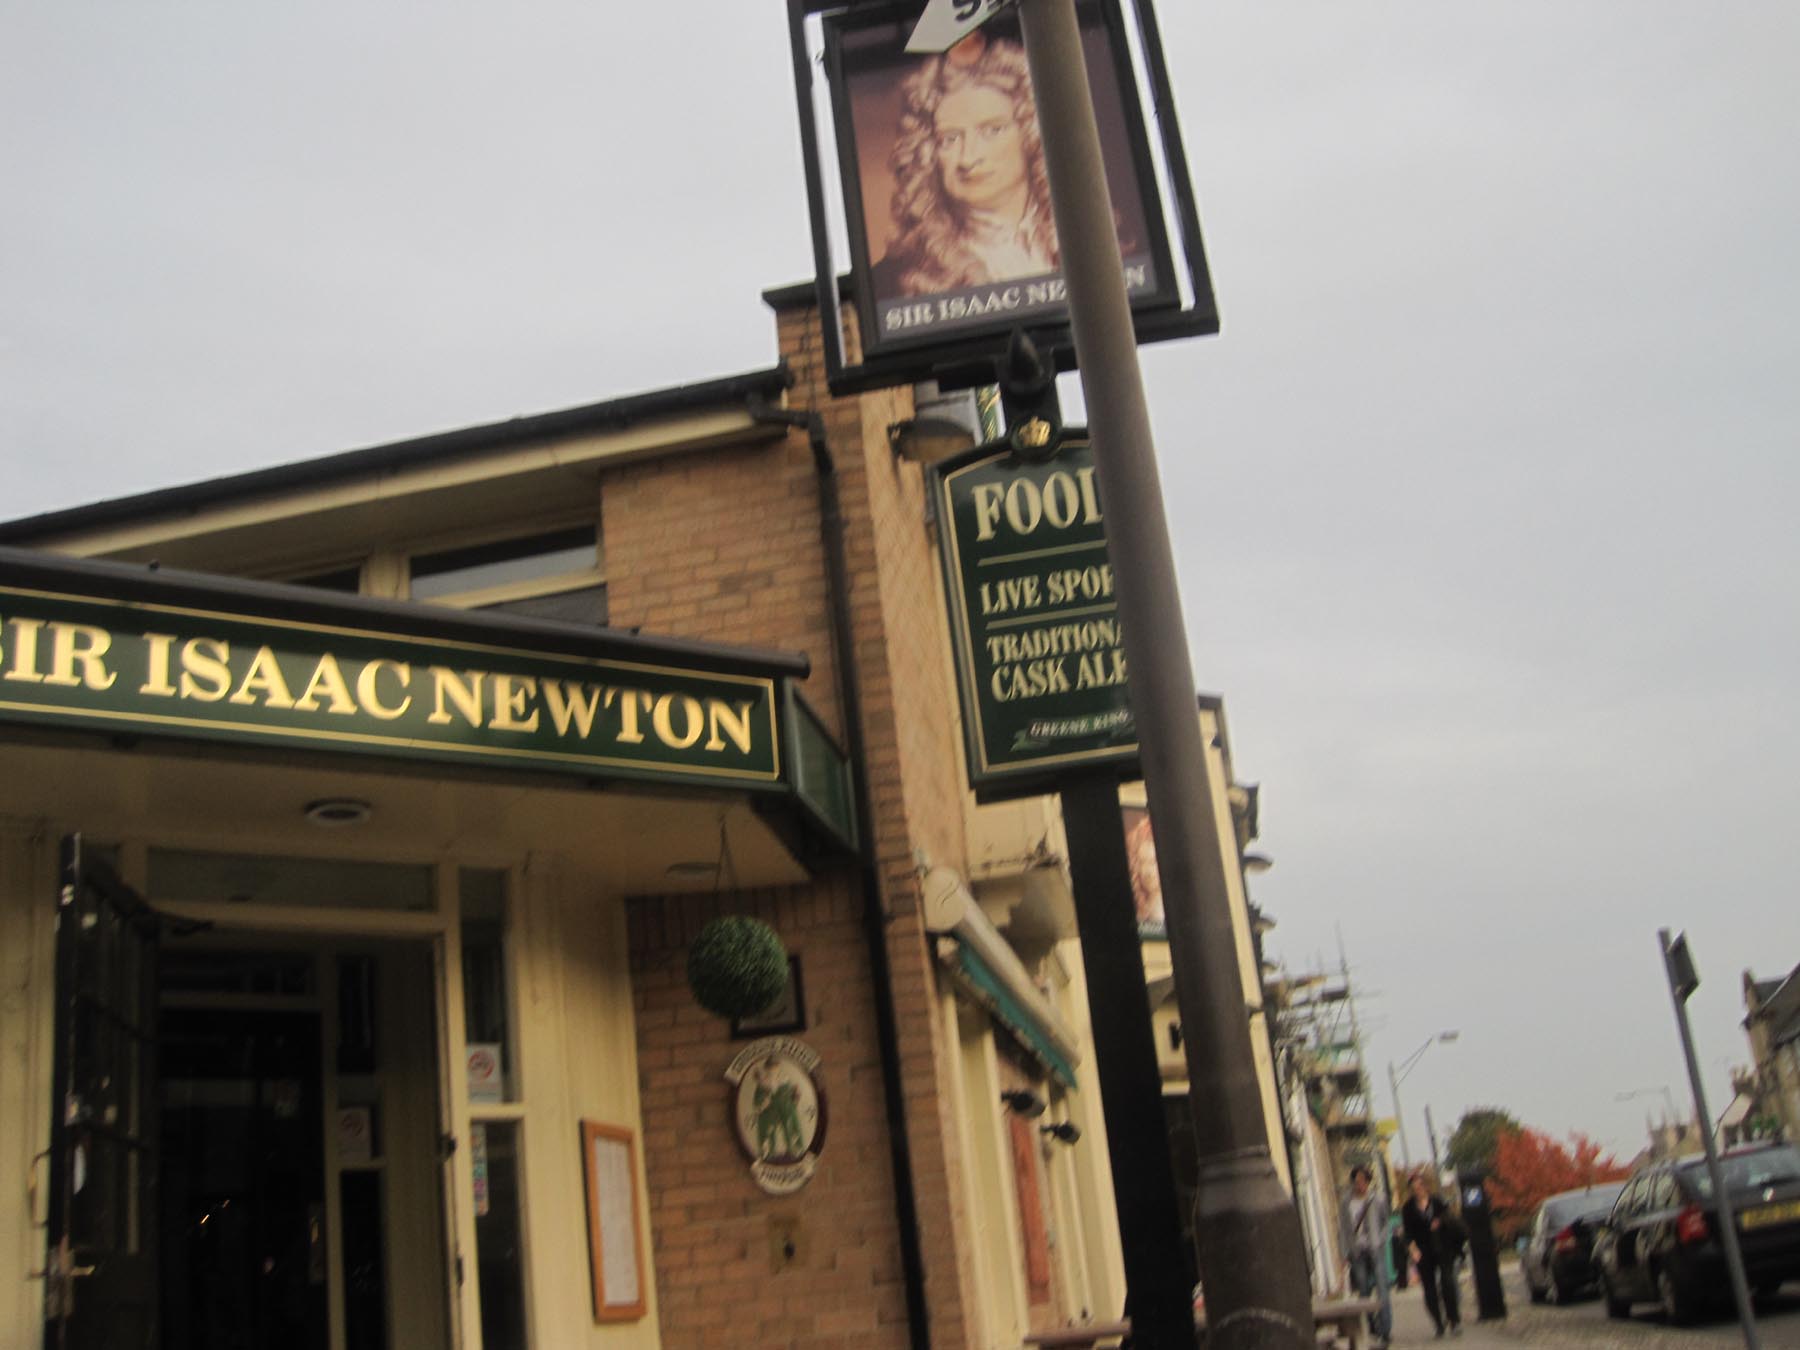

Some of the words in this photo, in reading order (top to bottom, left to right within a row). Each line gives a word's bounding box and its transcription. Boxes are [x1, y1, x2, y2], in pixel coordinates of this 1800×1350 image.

[886, 303, 935, 331] SIR
[939, 285, 1021, 321] ISAAC
[979, 575, 1042, 616] LIVE
[986, 617, 1122, 665] TRADITION
[0, 615, 117, 691] IR
[139, 631, 412, 721] ISAAC
[427, 664, 754, 755] NEWTON
[991, 656, 1071, 703] CASK
